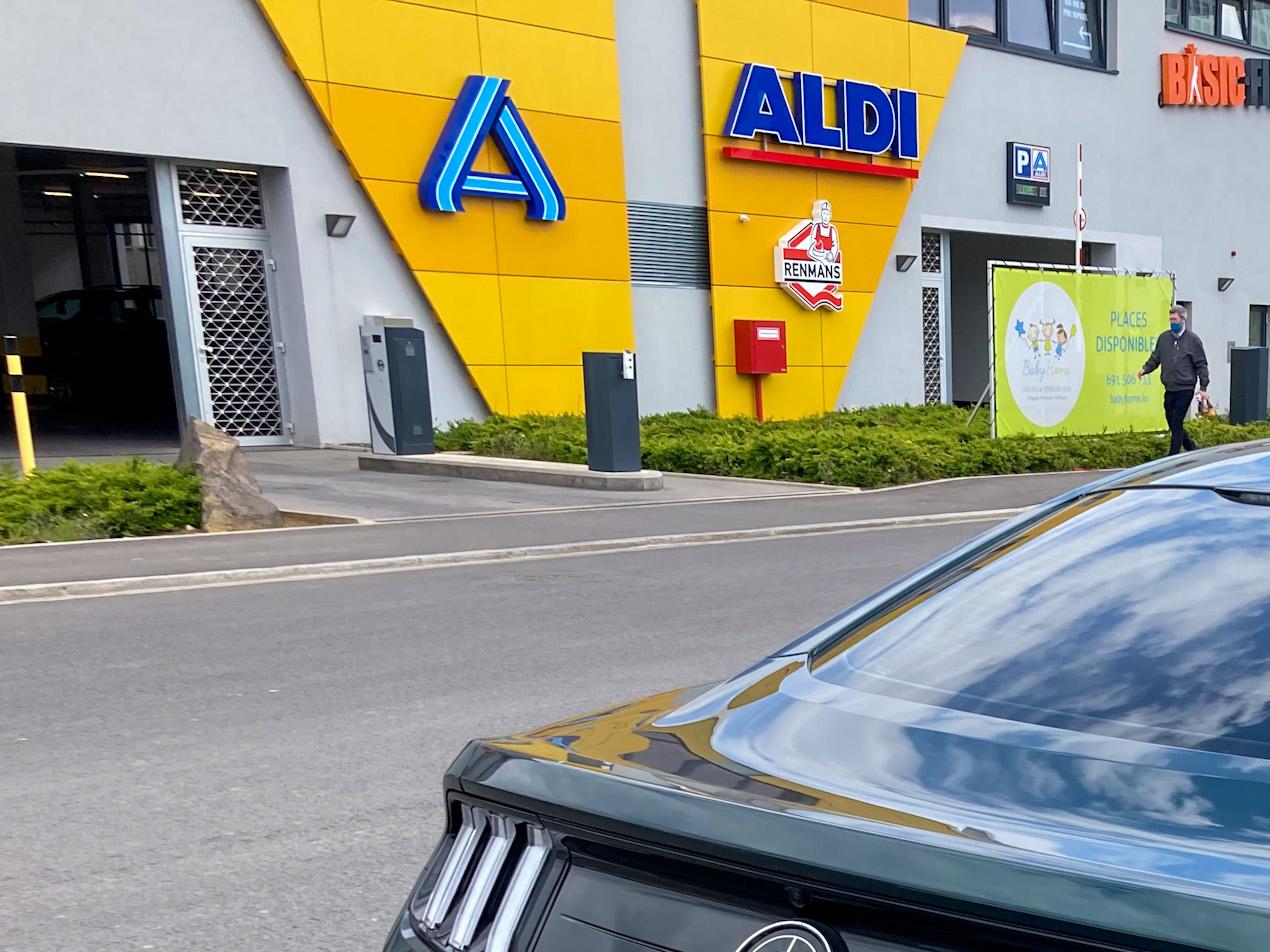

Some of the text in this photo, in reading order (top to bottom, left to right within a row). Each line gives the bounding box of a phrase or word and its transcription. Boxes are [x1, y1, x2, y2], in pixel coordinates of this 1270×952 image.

[723, 63, 919, 160] ALDI
[1017, 149, 1030, 174] P
[784, 262, 841, 279] RENMANS
[1110, 311, 1147, 328] PLACES
[1096, 336, 1159, 352] DISPONIBLE
[1106, 374, 1120, 386] 691
